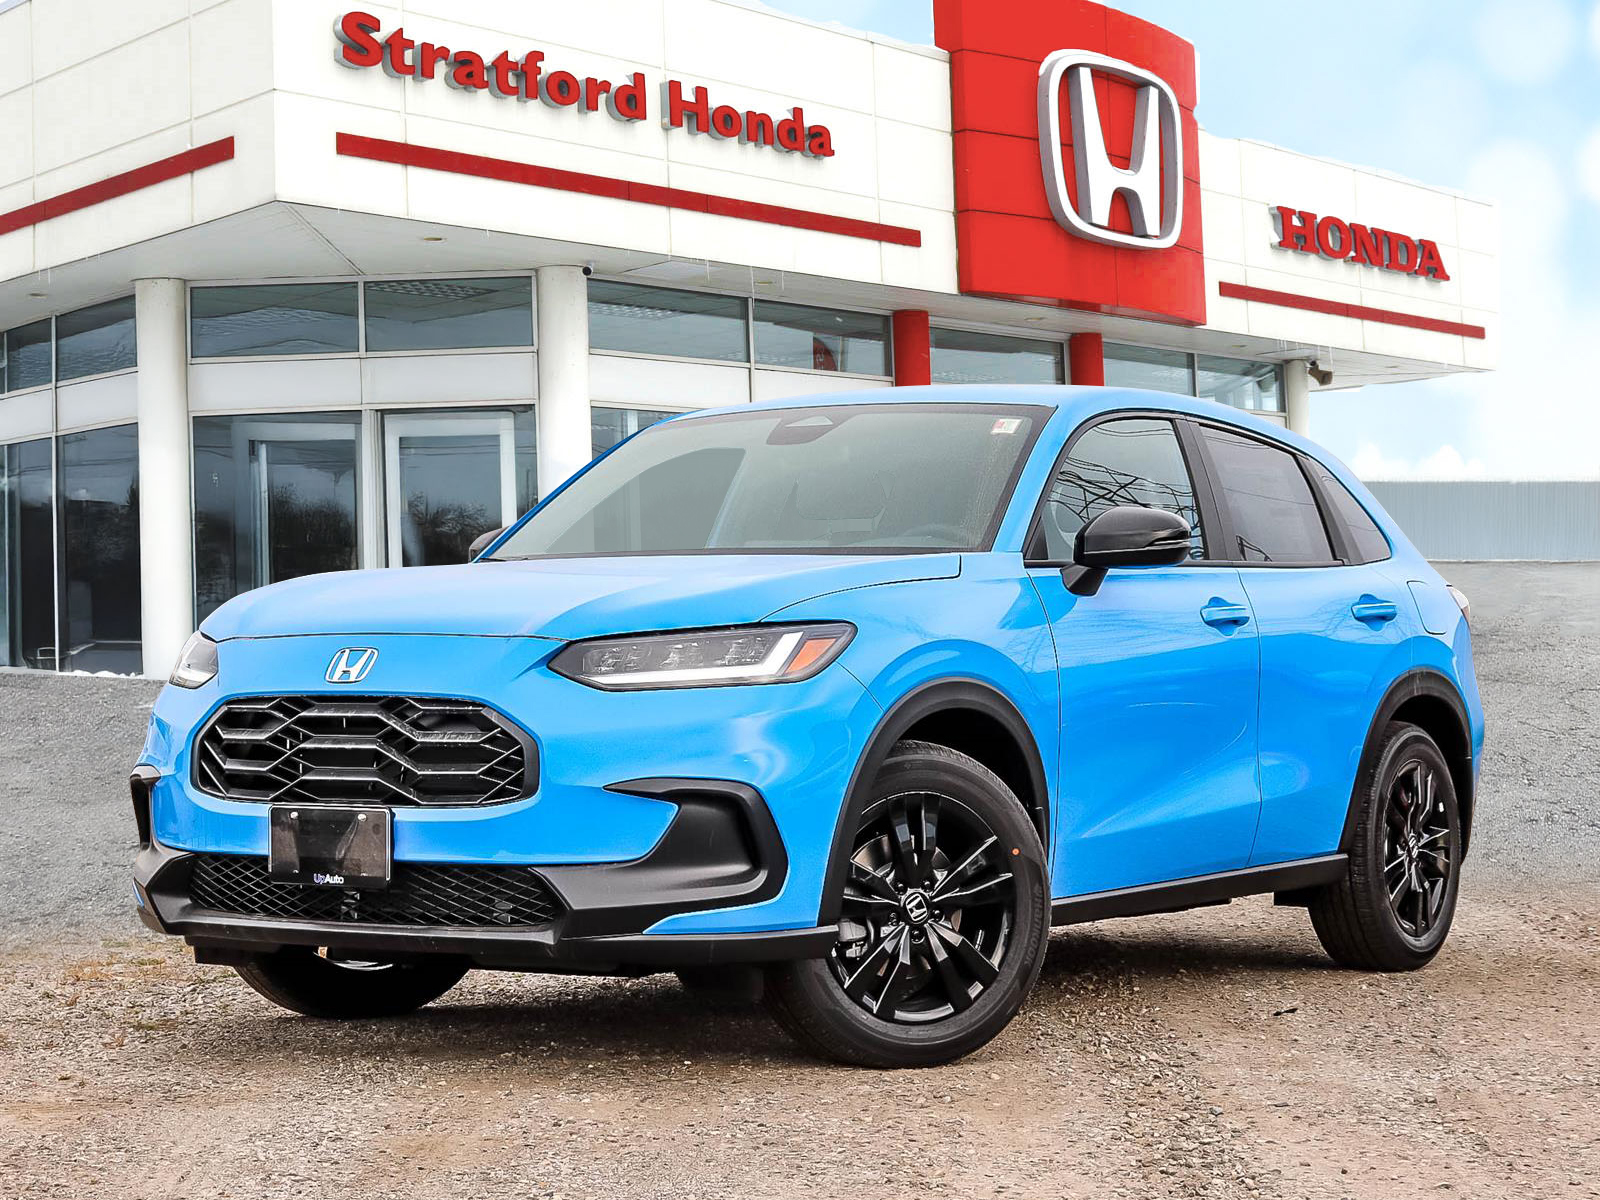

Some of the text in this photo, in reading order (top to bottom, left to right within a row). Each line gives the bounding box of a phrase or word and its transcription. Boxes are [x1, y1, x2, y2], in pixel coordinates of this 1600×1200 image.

[334, 11, 835, 157] Stratford Honda
[1269, 205, 1450, 282] HONDA
[313, 873, 345, 885] UpAuto
